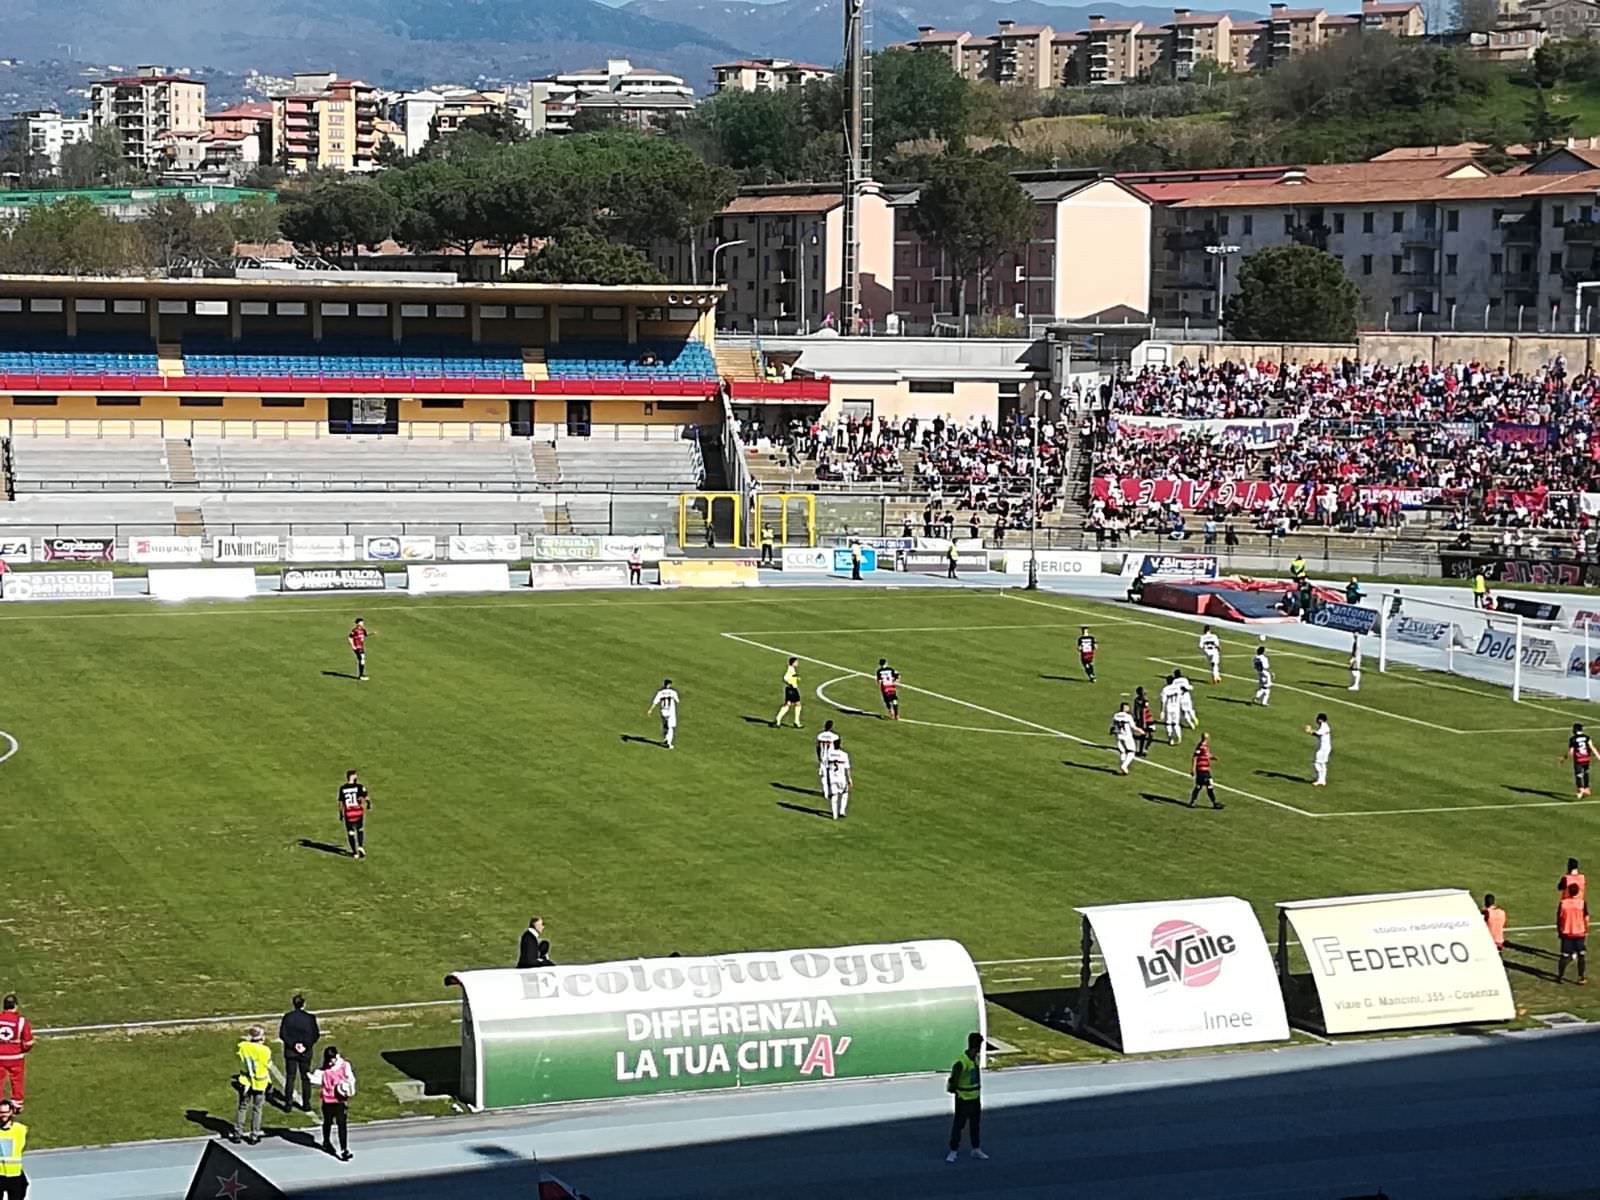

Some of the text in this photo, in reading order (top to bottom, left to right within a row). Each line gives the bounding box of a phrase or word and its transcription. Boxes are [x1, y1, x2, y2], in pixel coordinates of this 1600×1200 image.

[1329, 614, 1374, 630] senatore
[1333, 606, 1376, 622] antonio
[1476, 632, 1547, 667] Delcom
[344, 793, 358, 807] 21
[521, 946, 929, 998] Ecologia Oggi
[1312, 936, 1470, 976] FEDERICO
[1454, 988, 1500, 999] Cosenza
[626, 1000, 838, 1042] DIFFERENZIA
[616, 1050, 659, 1081] LA
[668, 1044, 731, 1076] TUA
